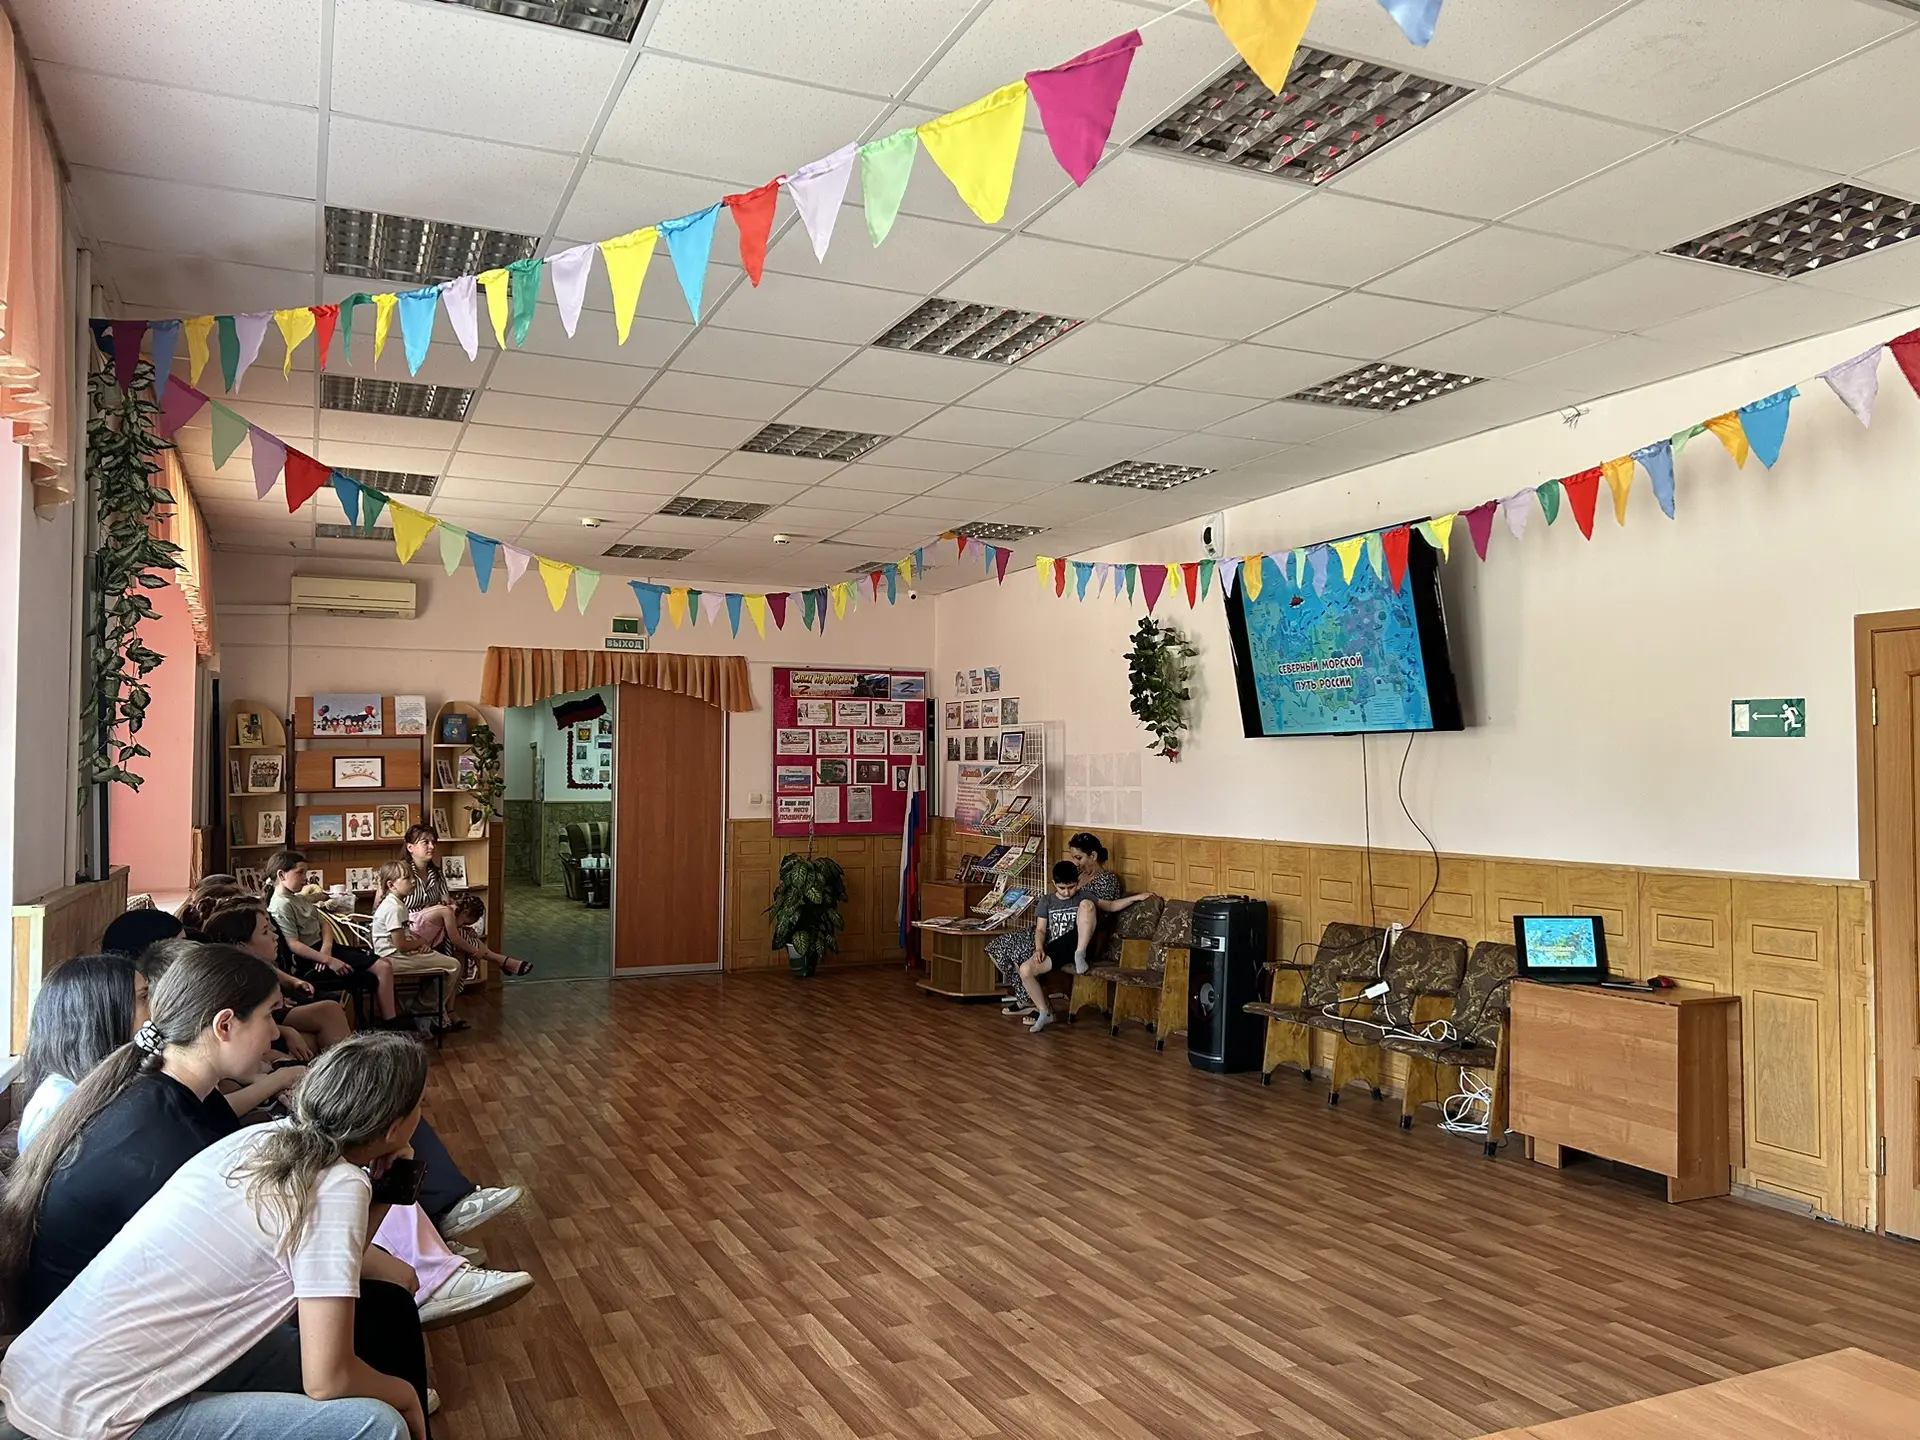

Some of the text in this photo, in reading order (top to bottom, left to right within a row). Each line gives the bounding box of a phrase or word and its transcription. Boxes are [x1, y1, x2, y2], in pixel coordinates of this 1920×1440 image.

[607, 639, 641, 648] ВЫХОД
[1278, 653, 1362, 674] СЕВЕРНЫЙ МОРСКОЙ
[1295, 676, 1351, 691] ПУТЬ РОССИИ
[1052, 912, 1077, 922] STATE
